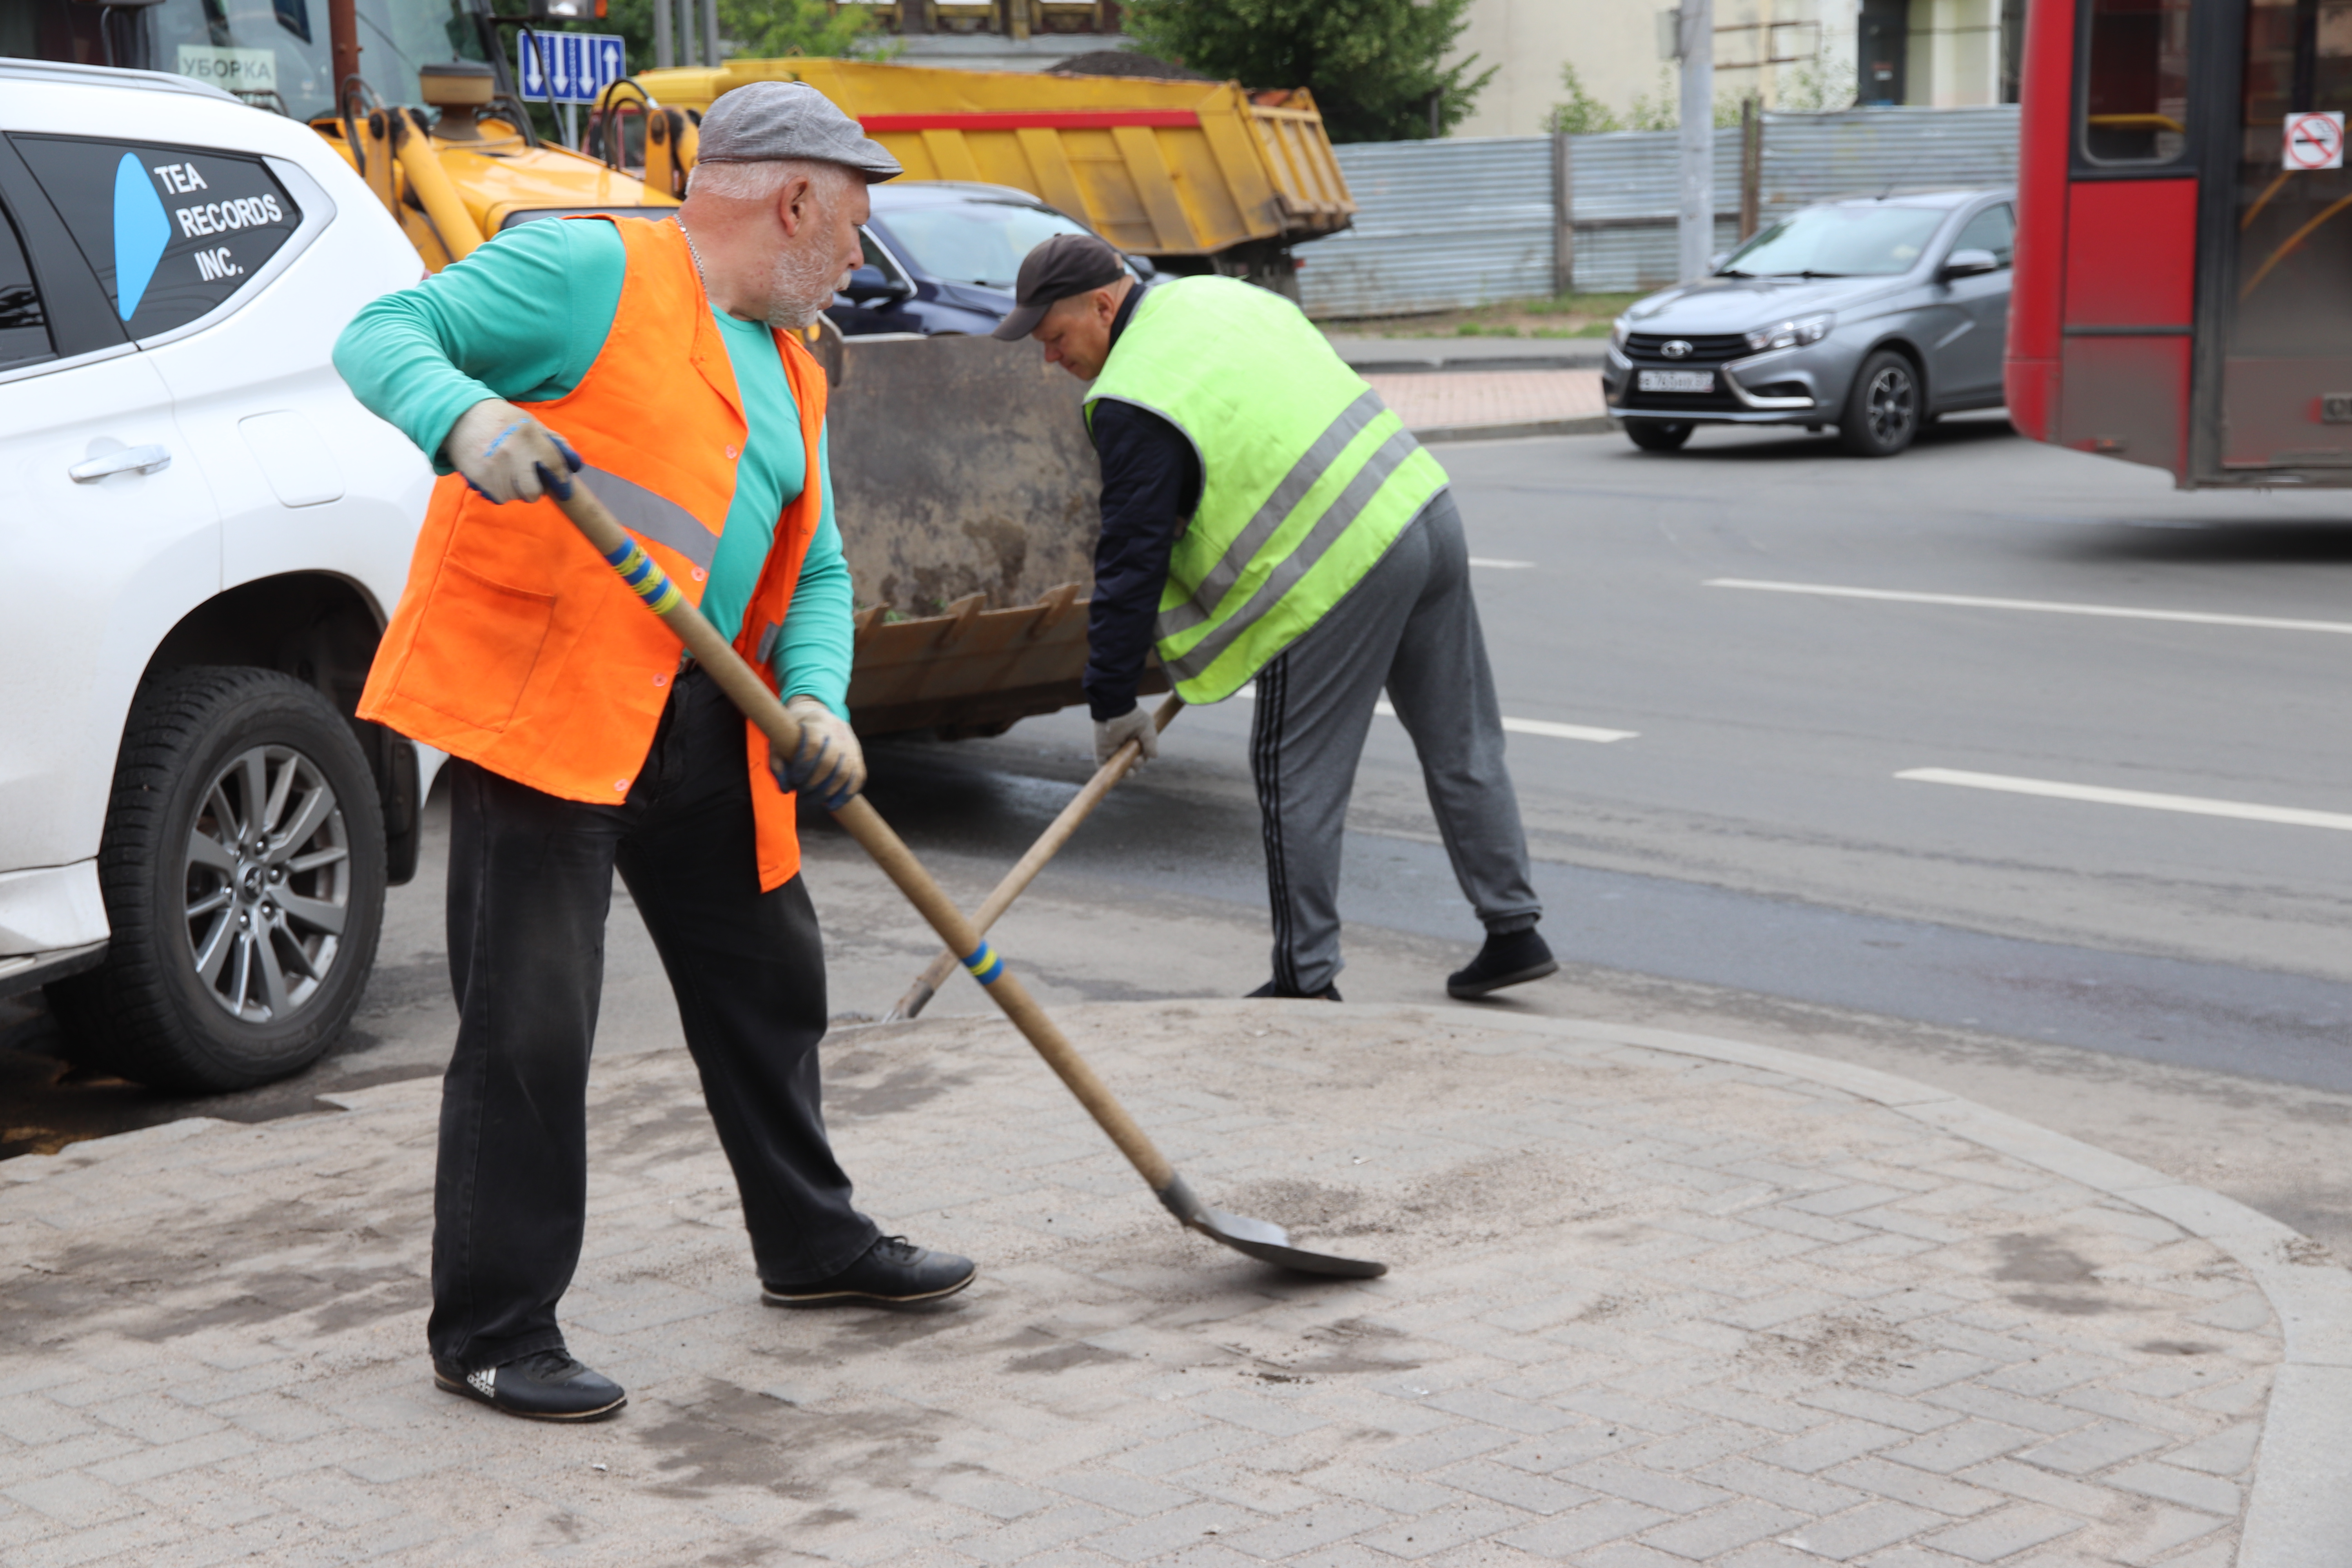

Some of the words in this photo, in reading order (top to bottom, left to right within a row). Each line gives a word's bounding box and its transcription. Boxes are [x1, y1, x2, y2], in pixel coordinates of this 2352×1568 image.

[182, 58, 272, 80] УБОРКА
[154, 163, 207, 194] TEA
[176, 194, 283, 238] RECORDS
[194, 247, 244, 281] INC.
[467, 1374, 495, 1398] adidas
